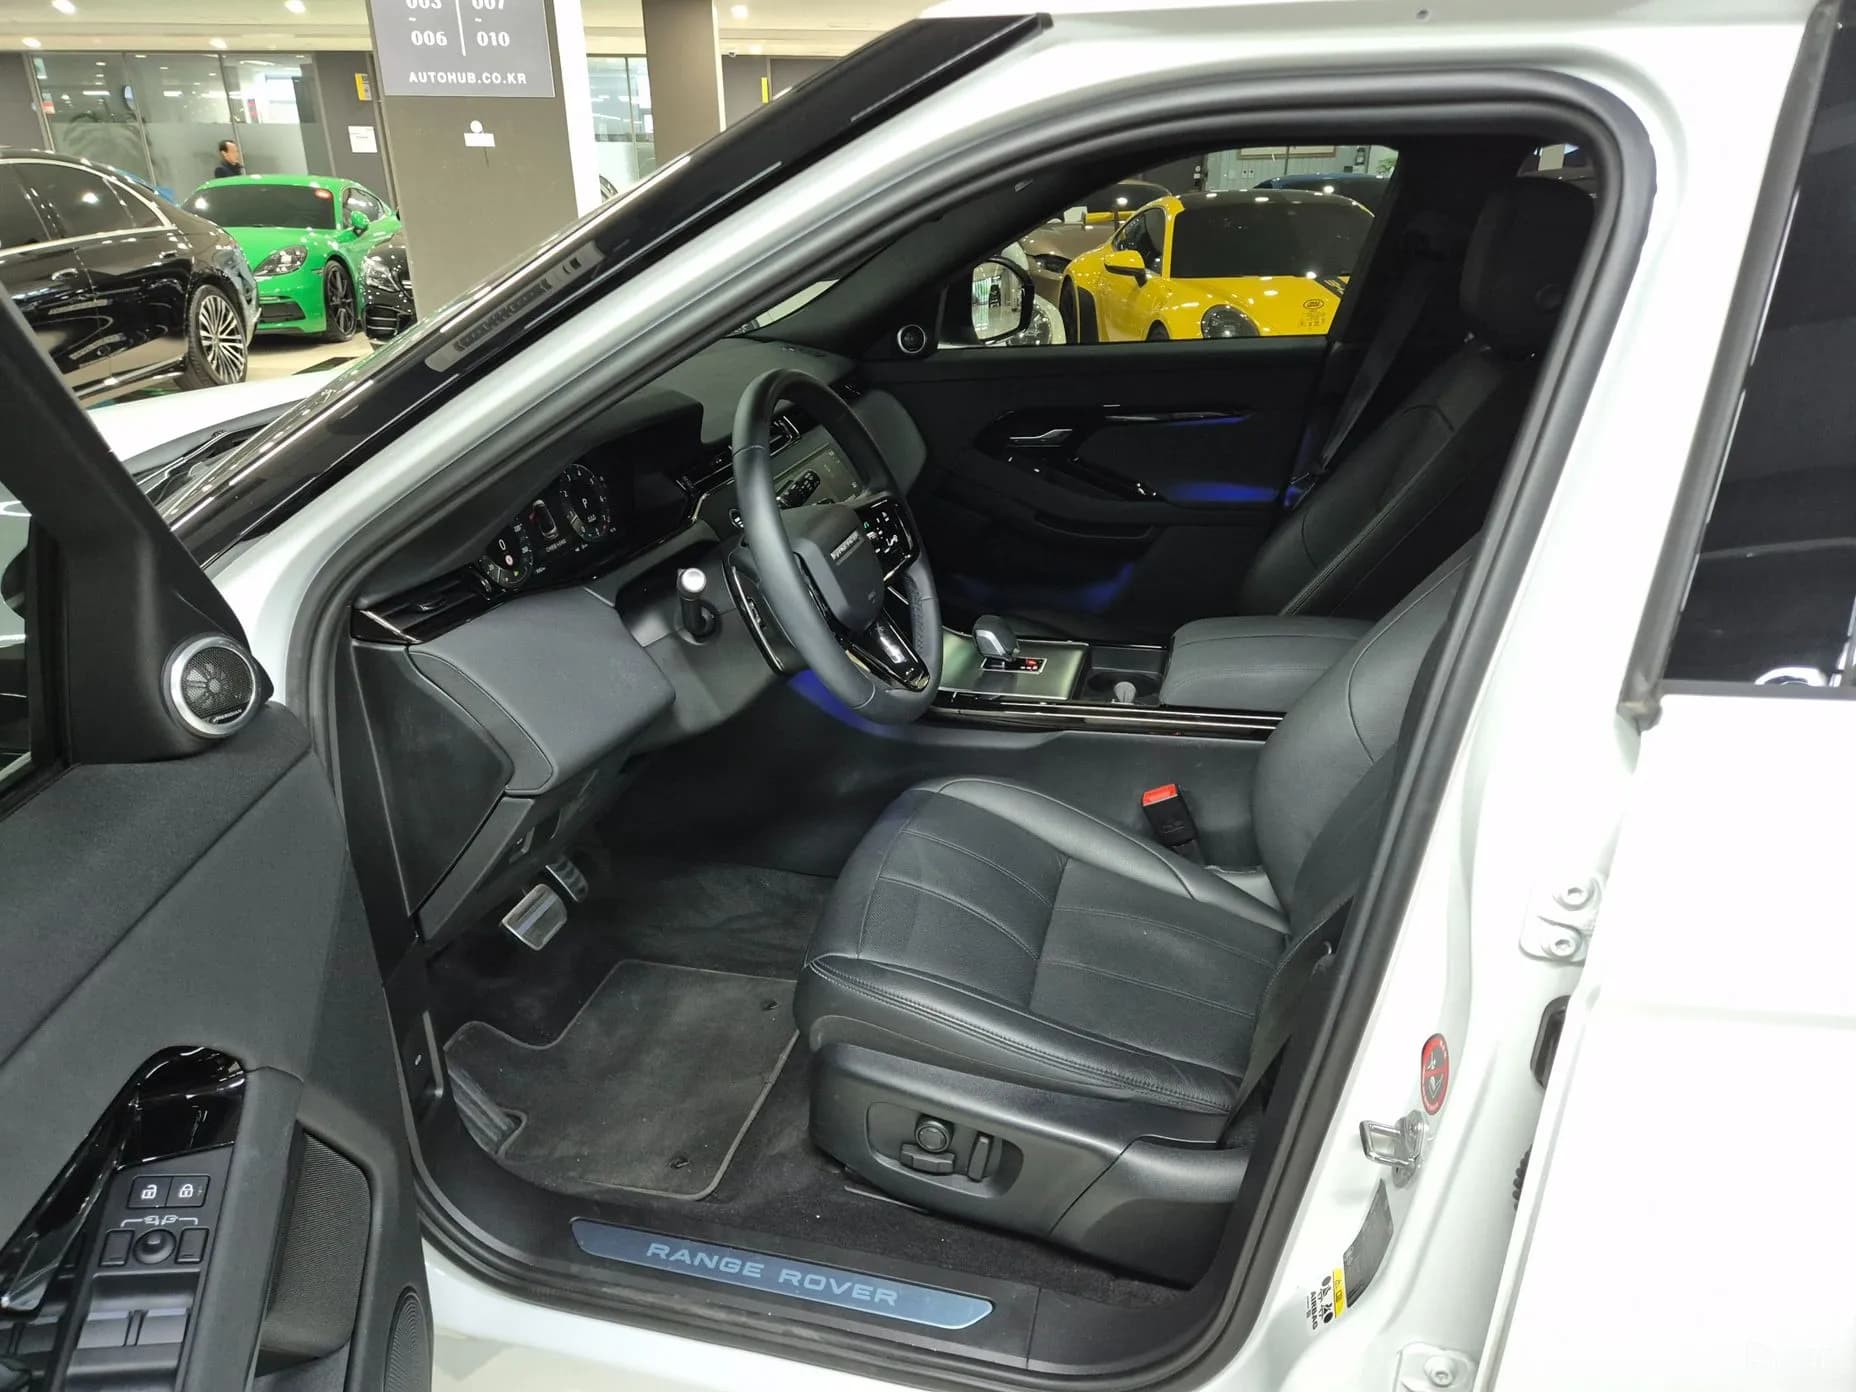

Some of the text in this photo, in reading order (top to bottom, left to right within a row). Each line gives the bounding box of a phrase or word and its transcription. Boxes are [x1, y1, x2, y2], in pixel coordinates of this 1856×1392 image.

[411, 30, 448, 46] 006
[477, 31, 510, 47] 010
[409, 71, 527, 84] AUTOHUB.CO.KR
[647, 1243, 899, 1306] RANGE ROVER
